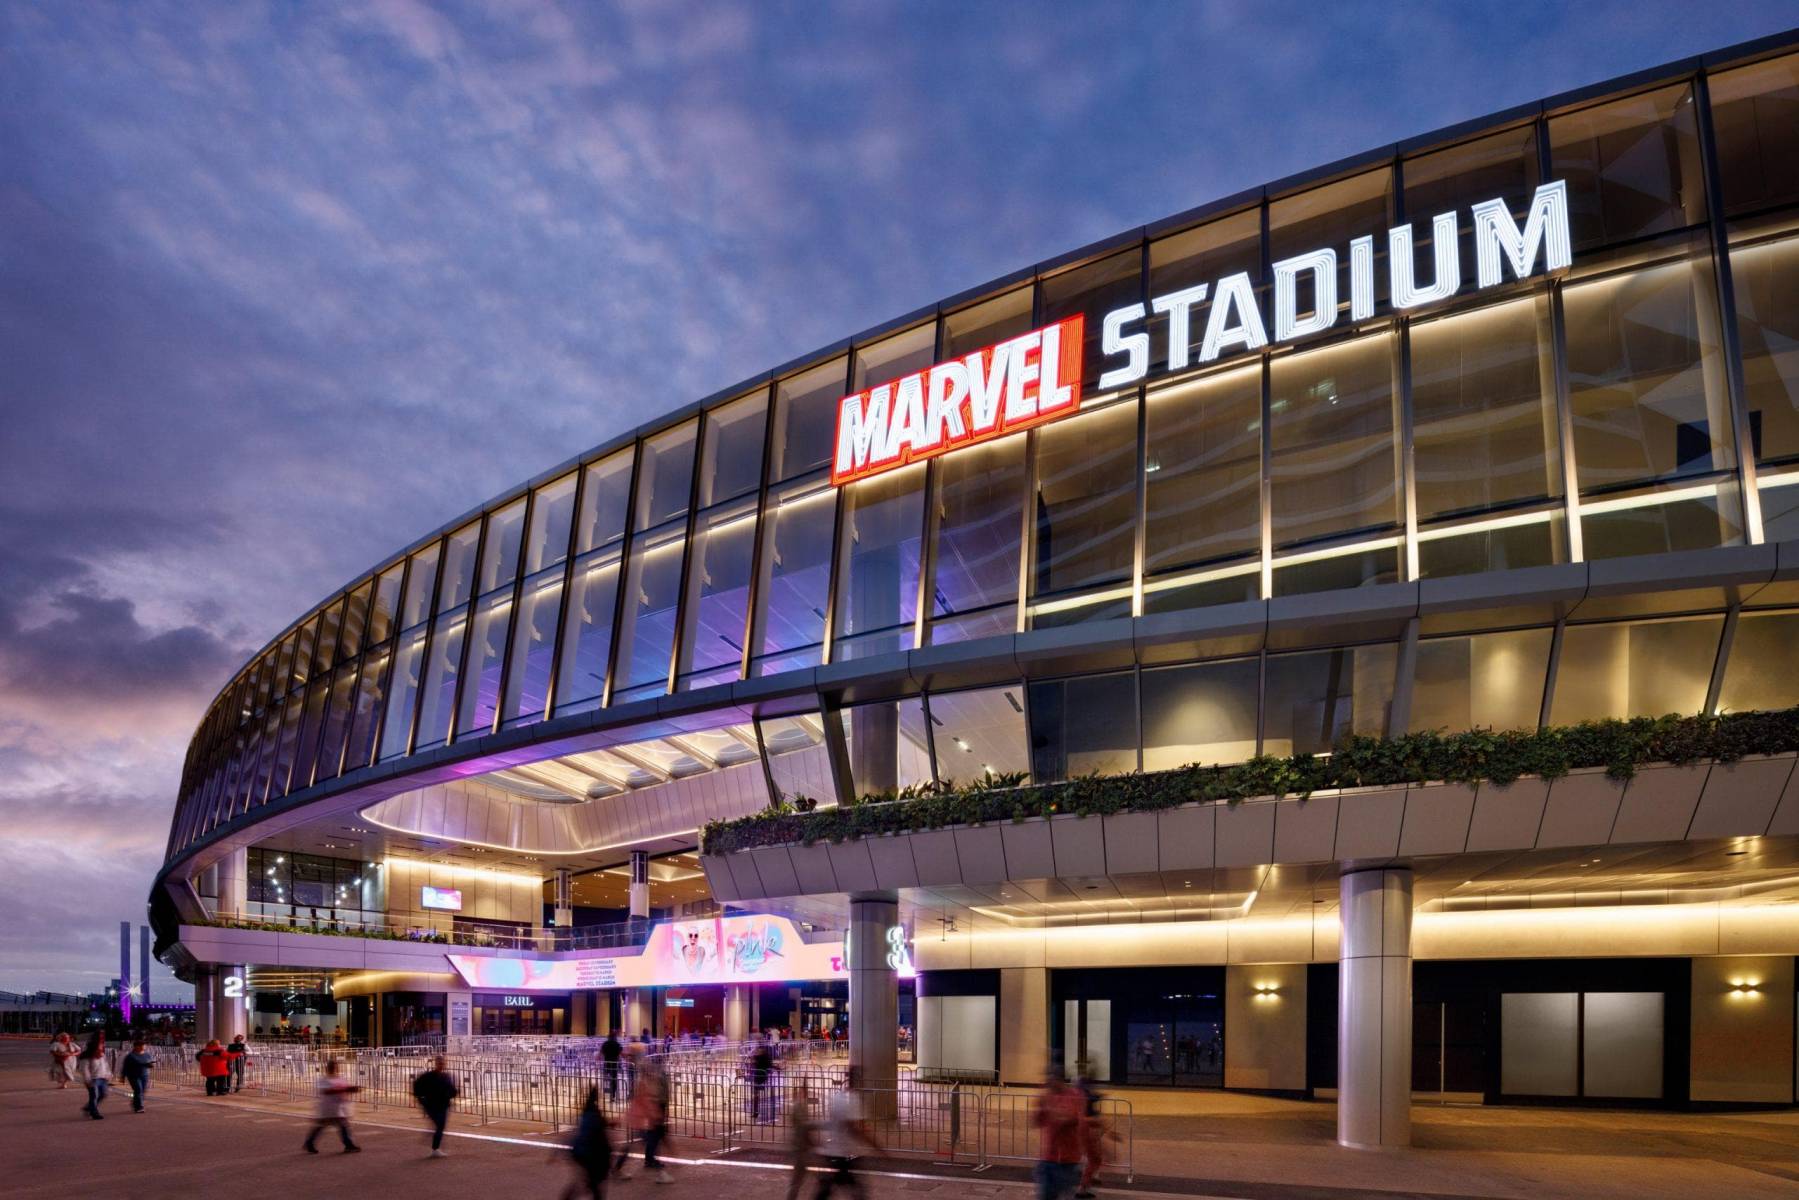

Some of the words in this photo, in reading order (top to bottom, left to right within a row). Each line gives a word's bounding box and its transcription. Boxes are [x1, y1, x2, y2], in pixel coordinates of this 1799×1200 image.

[836, 322, 1073, 475] MARVEL
[1098, 179, 1572, 390] STADIUM
[224, 976, 243, 998] 2
